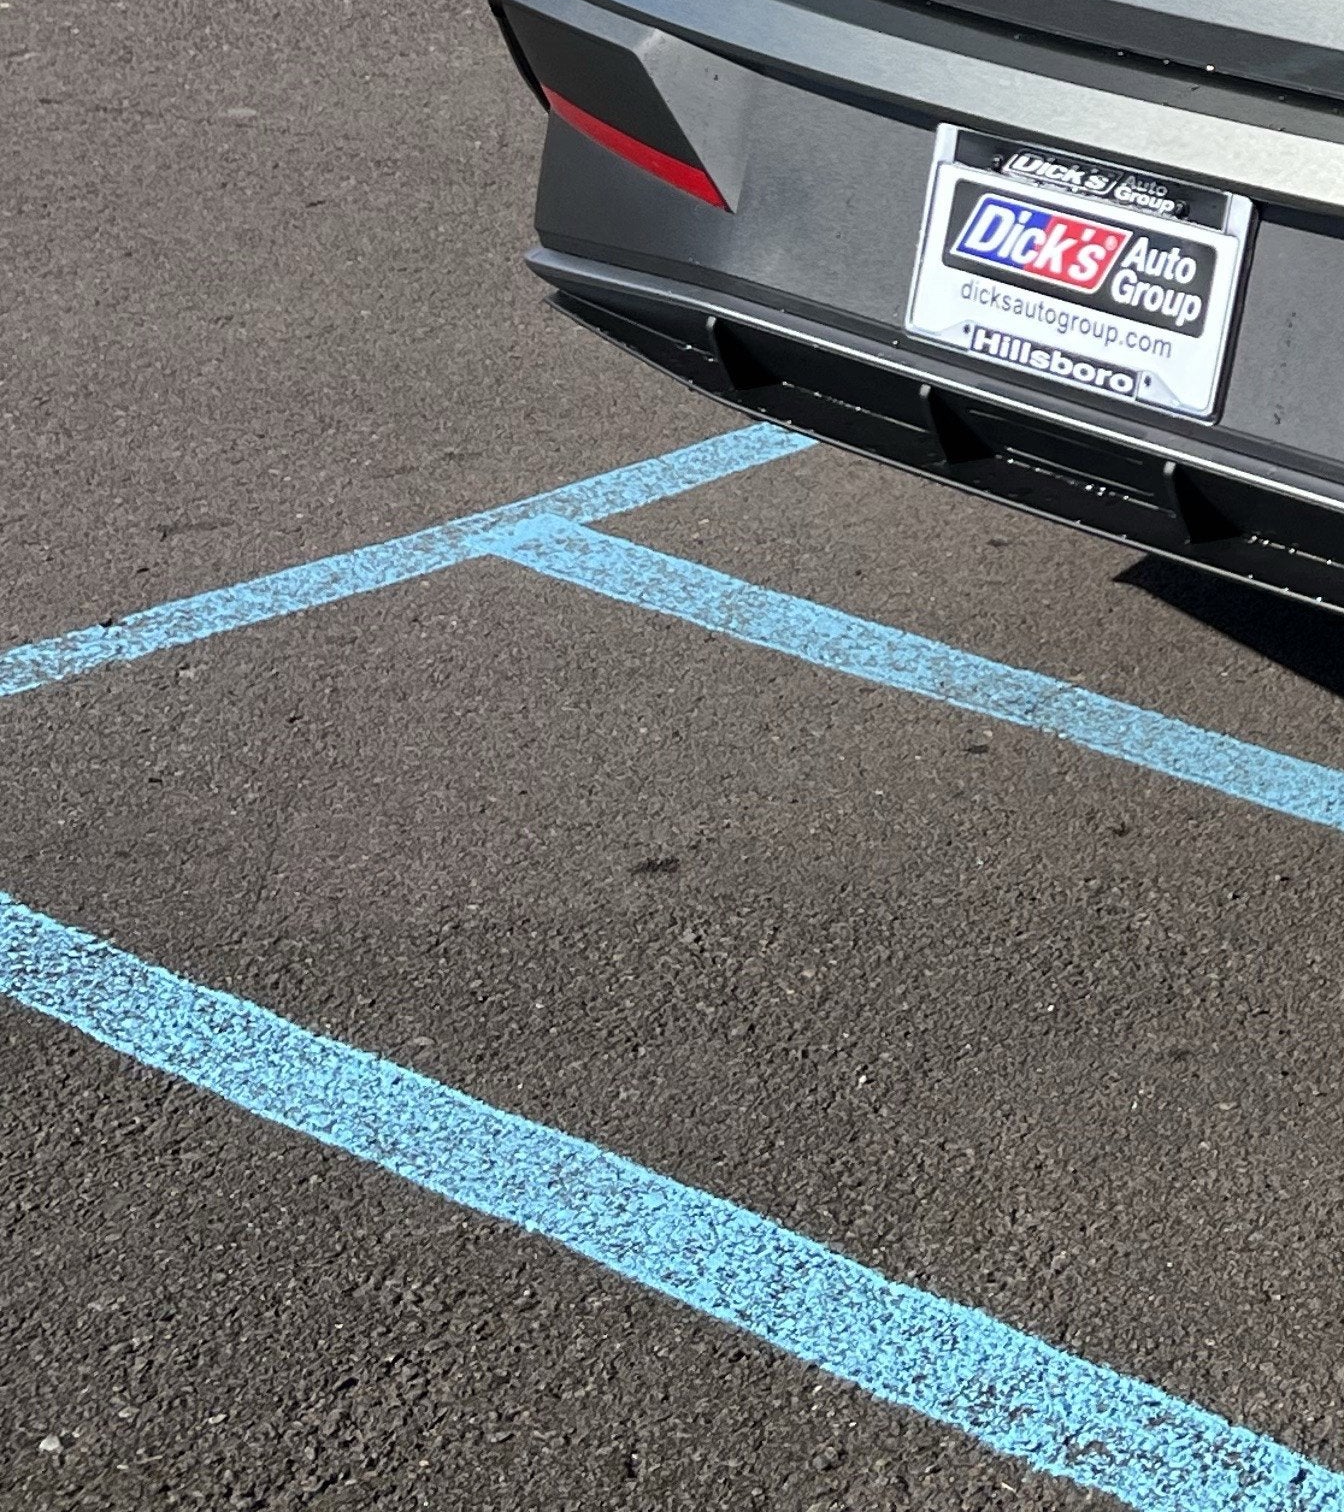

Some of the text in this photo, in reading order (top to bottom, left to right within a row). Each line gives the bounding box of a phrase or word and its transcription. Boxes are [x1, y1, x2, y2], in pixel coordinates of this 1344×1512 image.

[1009, 152, 1168, 197] Dick's Auto
[1113, 185, 1175, 214] Group
[963, 203, 1198, 284] Dick's Auto
[960, 279, 1173, 359] dicksautogroup.com
[1110, 268, 1203, 327] Group
[972, 328, 1134, 394] Hillsboro
